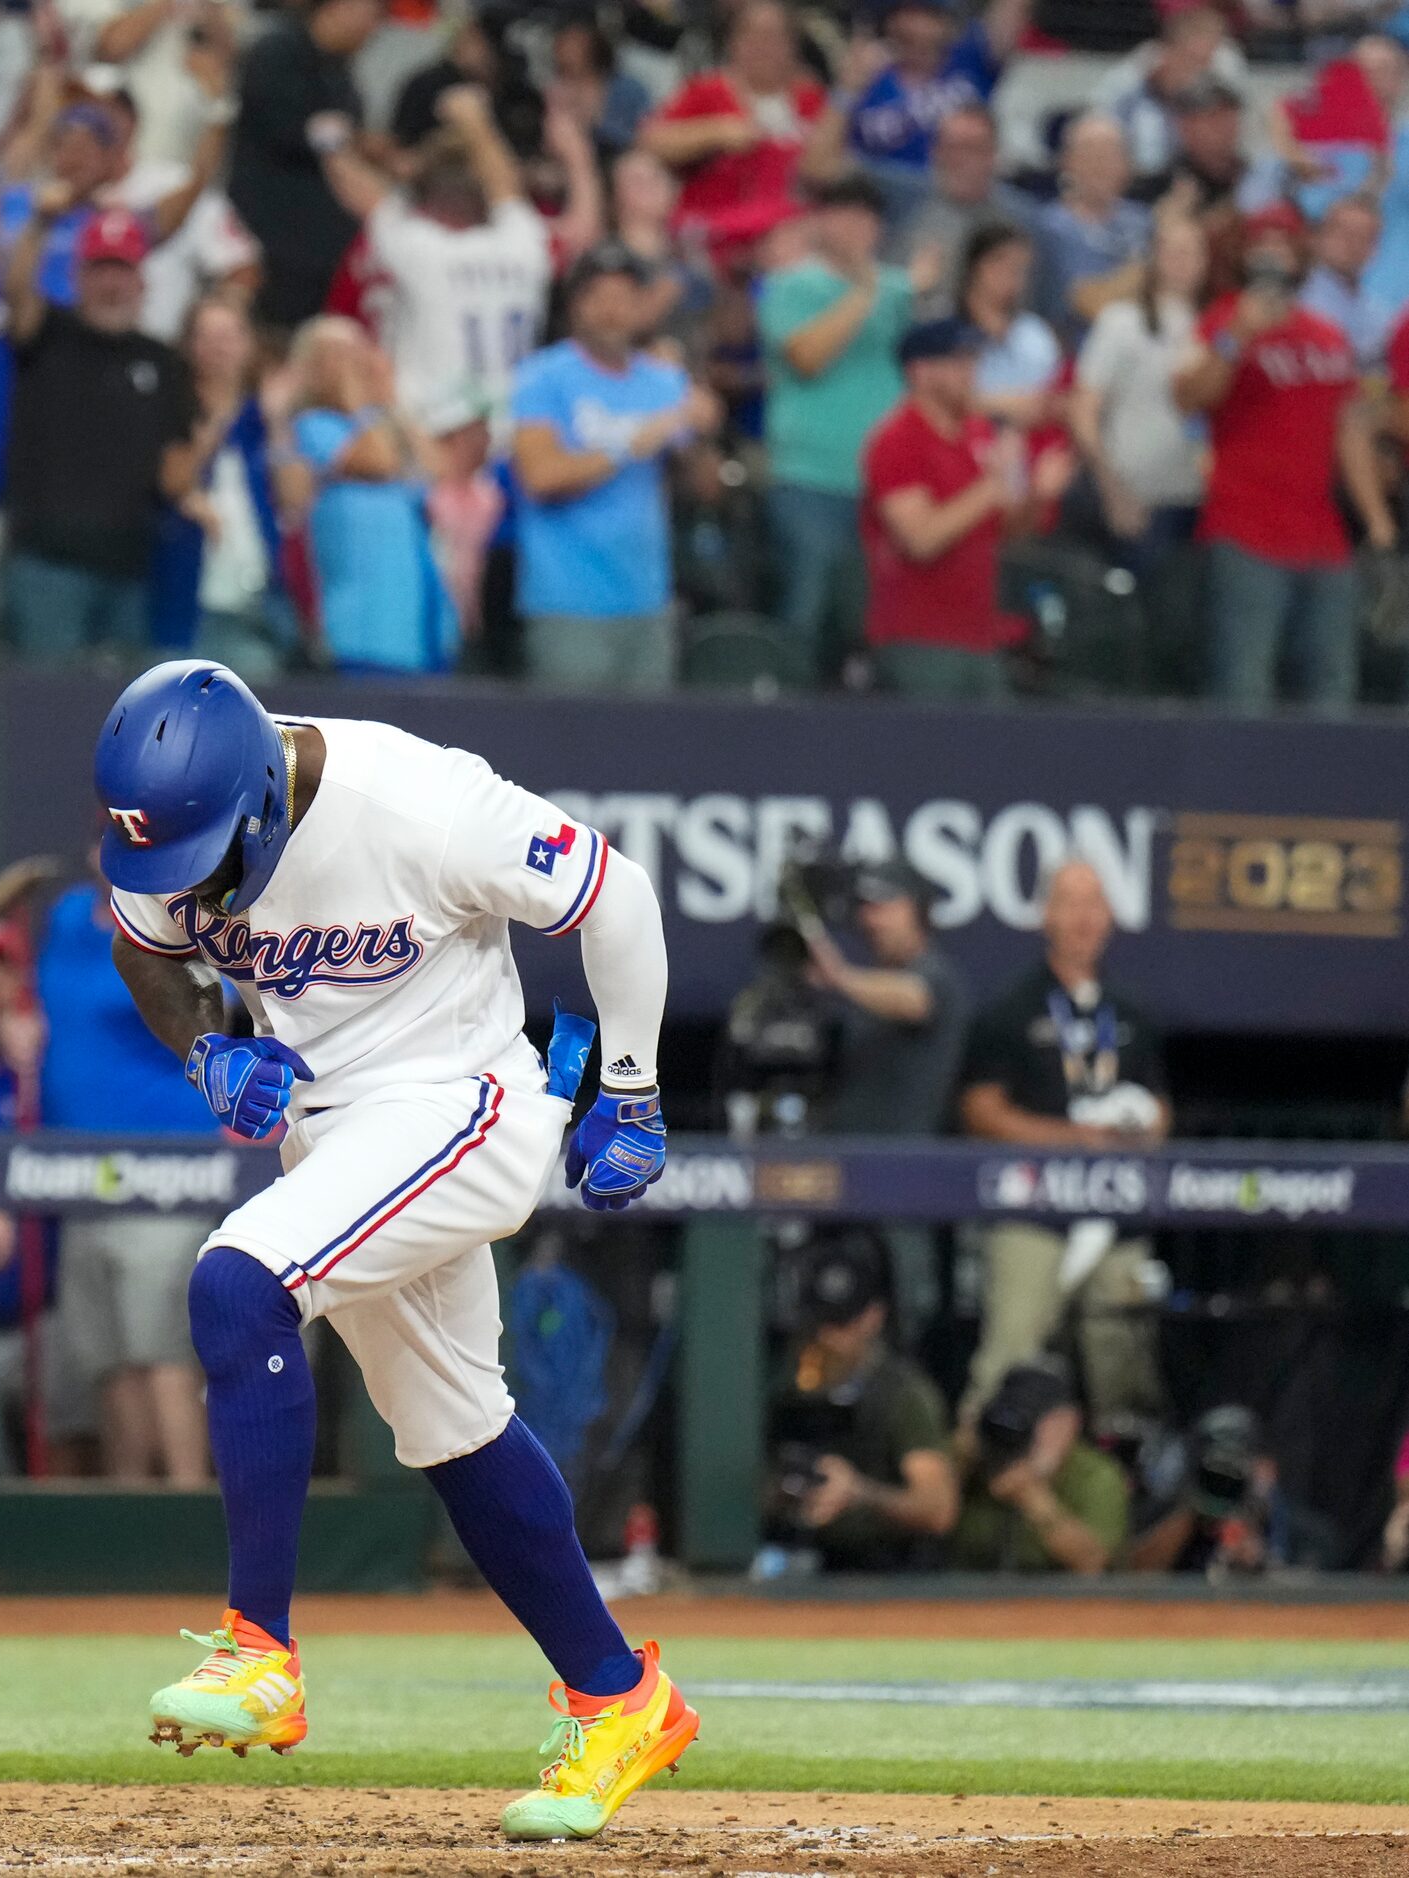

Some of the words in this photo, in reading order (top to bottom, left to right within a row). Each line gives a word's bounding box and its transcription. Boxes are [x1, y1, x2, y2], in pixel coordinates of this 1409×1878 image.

[108, 807, 152, 846] T
[165, 889, 425, 1000] Rangers
[607, 1065, 642, 1076] adidas
